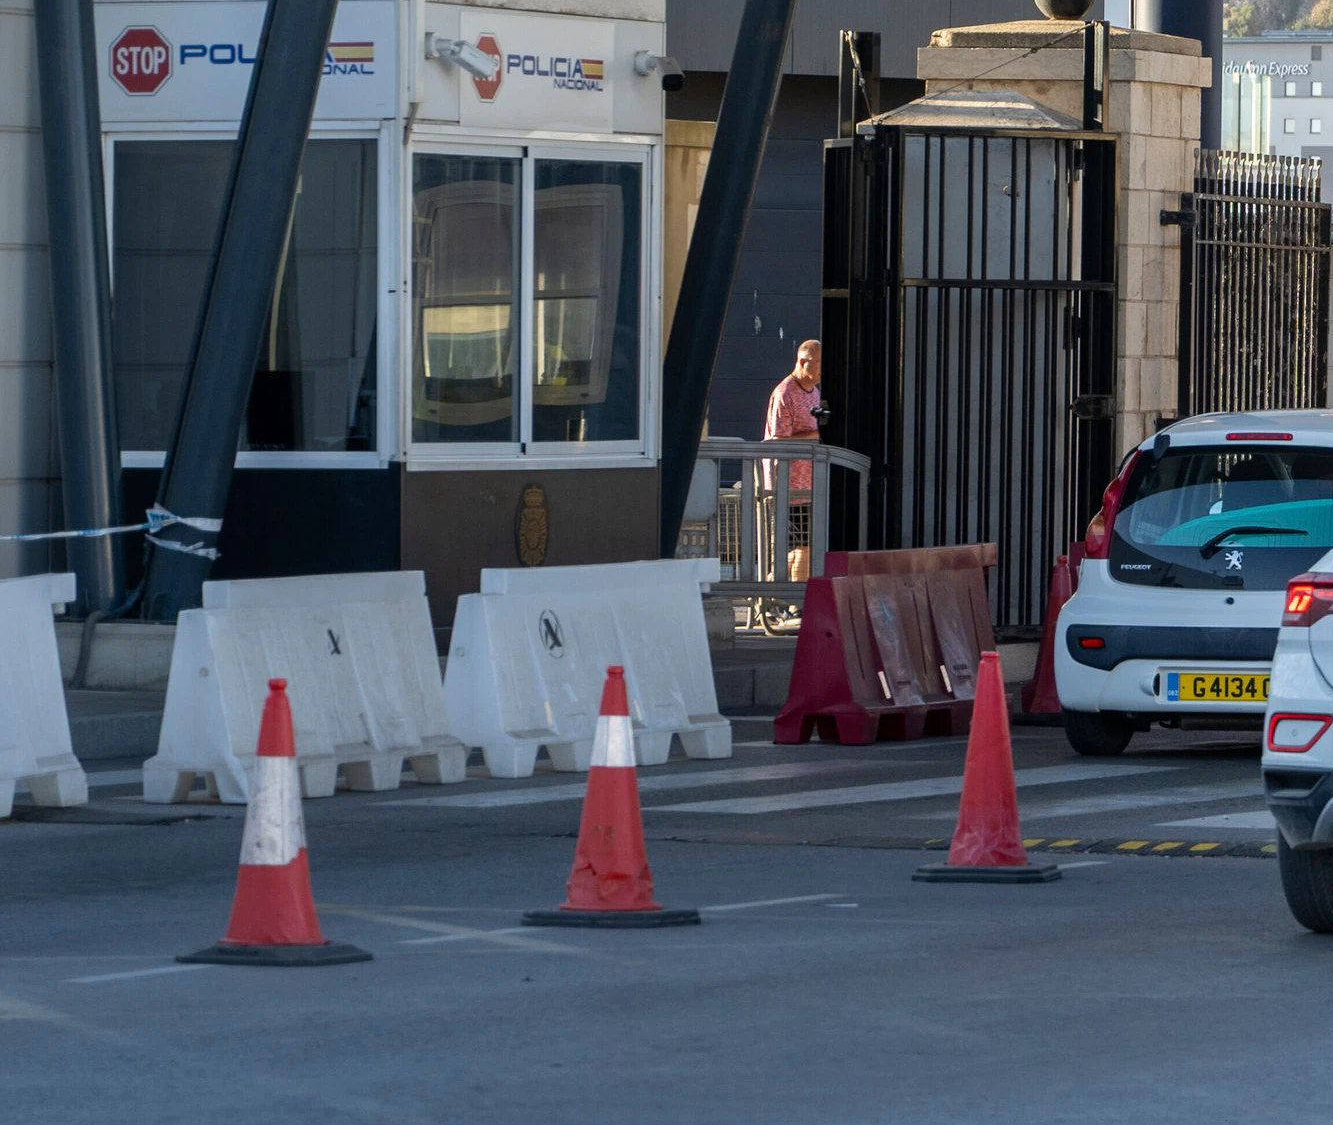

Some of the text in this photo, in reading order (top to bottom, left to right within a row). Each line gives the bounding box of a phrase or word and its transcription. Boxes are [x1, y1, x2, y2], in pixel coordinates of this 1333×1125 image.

[116, 46, 166, 76] STOP
[1268, 61, 1309, 79] Express
[553, 78, 604, 92] NACIONAL
